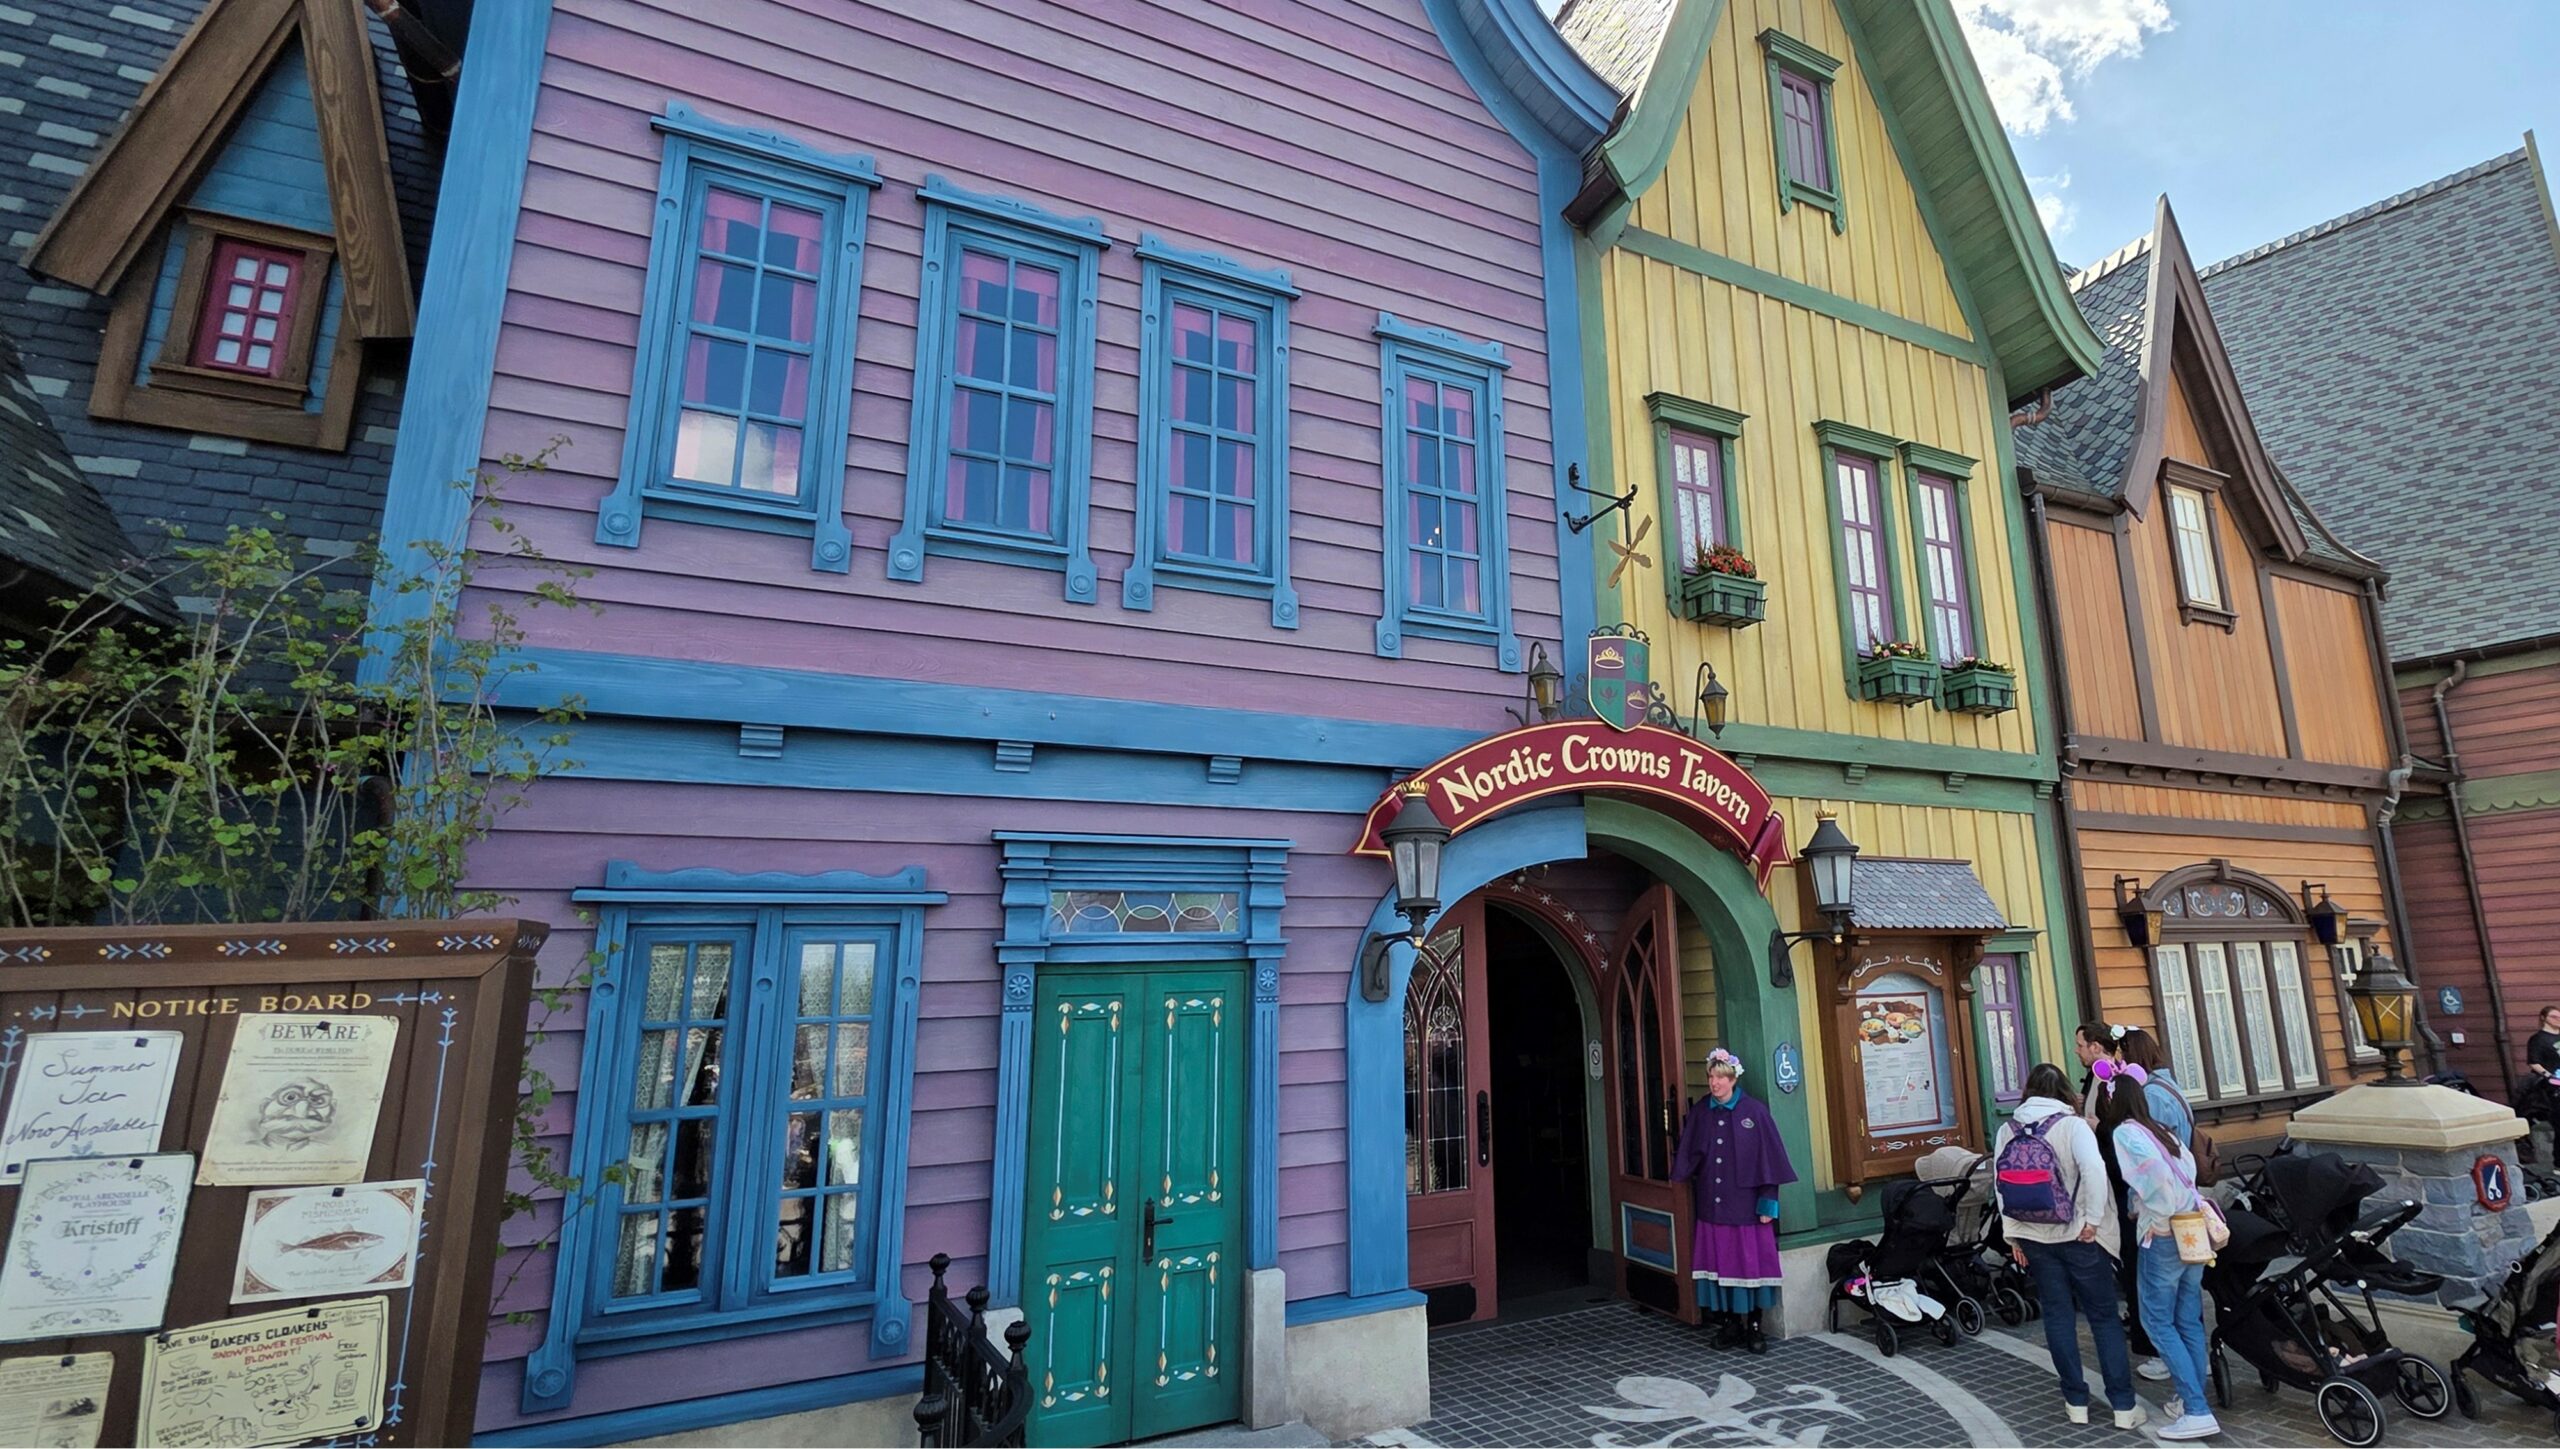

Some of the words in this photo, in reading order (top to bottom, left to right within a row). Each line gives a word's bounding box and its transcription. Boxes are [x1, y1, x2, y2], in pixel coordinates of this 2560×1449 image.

[1437, 745, 1553, 814] Nordic
[1561, 734, 1671, 780] Crowns
[1679, 747, 1751, 826] Tavern
[112, 998, 239, 1019] NOTICE
[260, 993, 372, 1012] BOARD
[270, 1024, 362, 1040] BEWARE
[43, 1049, 155, 1077] Summer
[59, 1075, 127, 1105] Ice
[6, 1112, 63, 1145] Now
[51, 1113, 159, 1148] Available
[58, 1194, 91, 1202] ROYAL
[95, 1190, 149, 1200] ARENDELLE
[72, 1199, 132, 1209] PLAYHOUSE
[61, 1216, 144, 1238] Kristoff
[158, 1339, 183, 1353] SAVE
[210, 1332, 261, 1349] OAKEN'S
[266, 1320, 329, 1340] CLOAKENS
[211, 1339, 287, 1360] SNOWFLOWER
[289, 1331, 335, 1347] FESTIVAL
